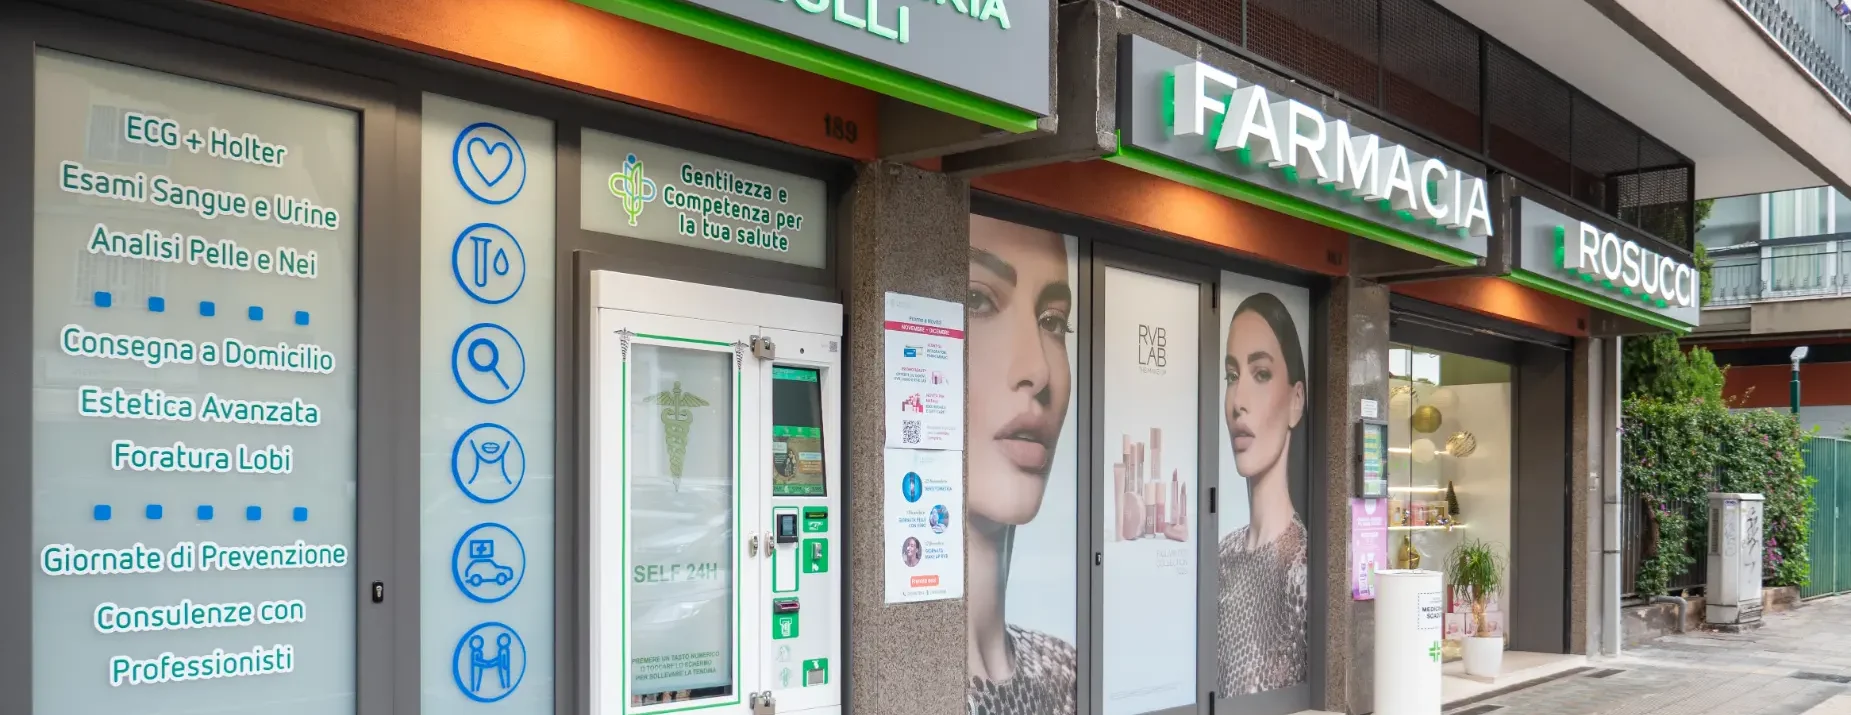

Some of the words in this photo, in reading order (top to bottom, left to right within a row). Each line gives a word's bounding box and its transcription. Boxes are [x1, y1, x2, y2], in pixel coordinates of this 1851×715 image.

[127, 115, 178, 146] ECG
[187, 132, 203, 151] +
[210, 130, 286, 165] Holter
[824, 113, 858, 143] 189
[1178, 60, 1493, 237] FARMACIA
[63, 164, 144, 199] Esami
[153, 178, 247, 216] Sangue
[255, 198, 268, 217] e
[276, 197, 338, 228] Urine
[681, 164, 772, 200] Gentilezza
[778, 187, 788, 203] e
[664, 186, 770, 223] Competenza
[776, 211, 803, 231] per
[680, 214, 696, 235] la
[702, 219, 730, 241] tua
[737, 227, 789, 250] salute
[91, 227, 181, 260] Analisi
[190, 238, 249, 268] Pelle
[257, 251, 271, 270] e
[280, 249, 316, 277] Nei
[1572, 220, 1697, 308] ROSUCCI
[64, 327, 194, 365] Consegna
[203, 344, 216, 363] a
[226, 340, 333, 371] Domicilio
[1138, 323, 1167, 348] RVB
[1138, 344, 1167, 367] LAB
[81, 388, 193, 418] Estetica
[201, 395, 318, 424] Avanzata
[114, 443, 230, 470] Foratura
[239, 447, 291, 472] Lobi
[44, 546, 161, 572] Giornate
[170, 544, 193, 569] di
[202, 542, 346, 568] Prevenzione
[634, 564, 680, 583] SELF
[687, 562, 718, 581] 24H
[97, 602, 251, 630] Consulenze
[261, 602, 304, 621] con
[113, 647, 292, 683] Professionisti
[691, 651, 720, 659] NUMERICO
